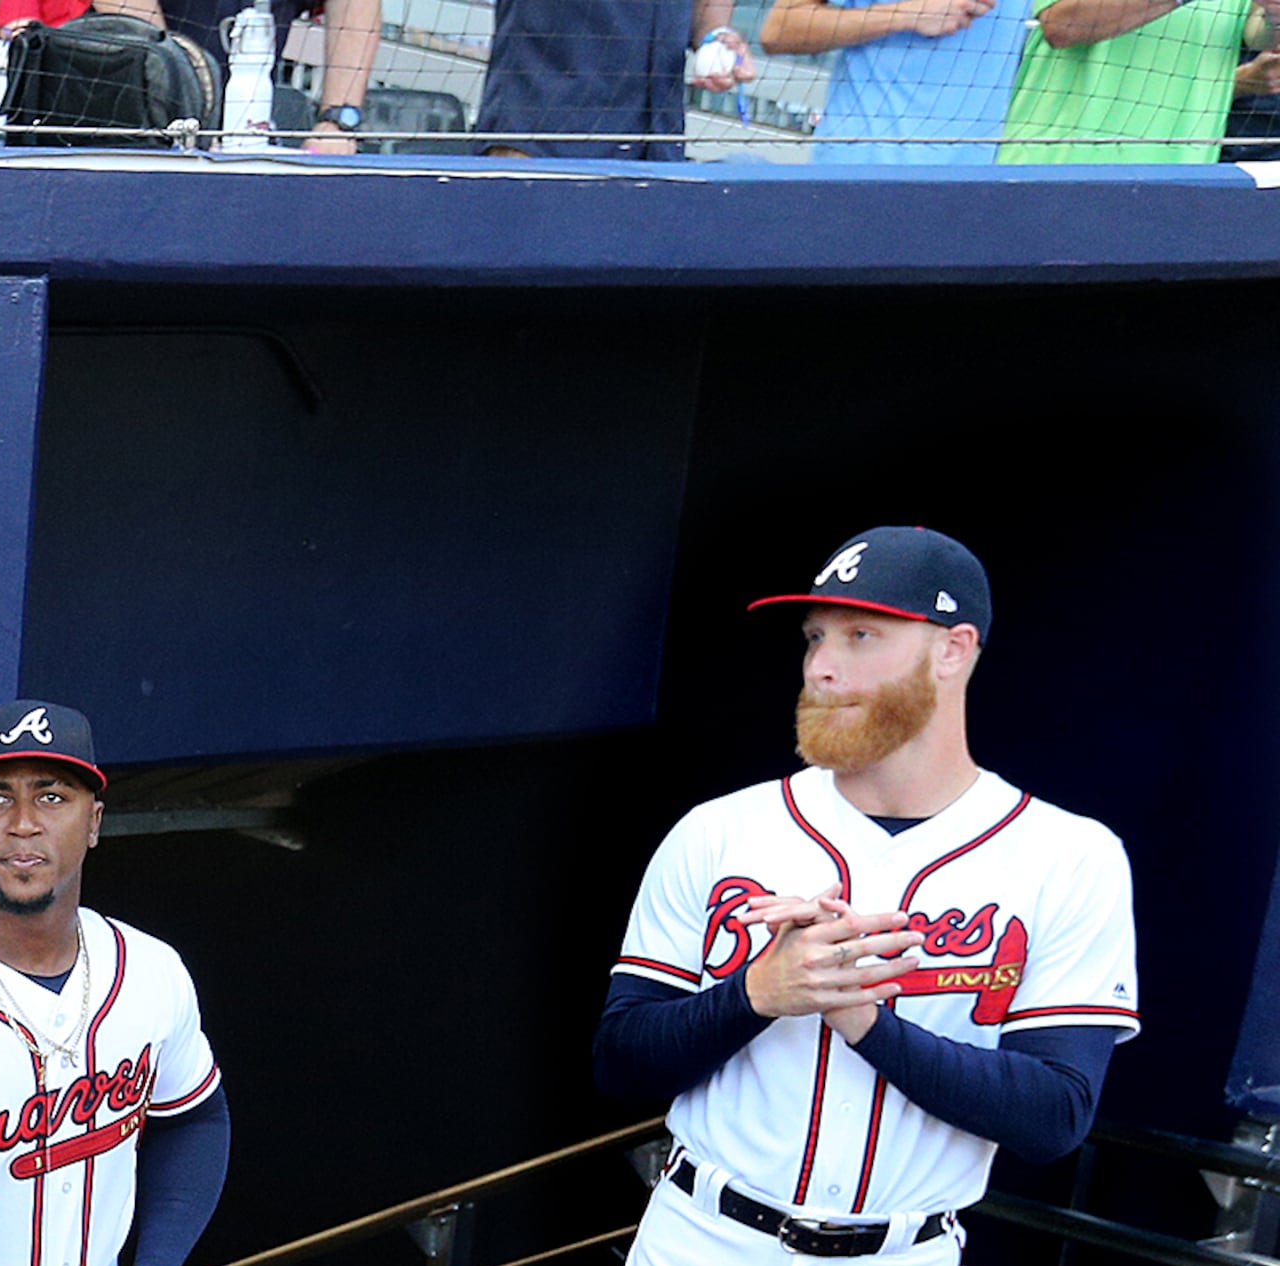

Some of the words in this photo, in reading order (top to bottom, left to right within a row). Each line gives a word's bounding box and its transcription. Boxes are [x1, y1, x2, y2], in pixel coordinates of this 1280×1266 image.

[814, 541, 868, 586] A
[0, 707, 53, 745] A
[703, 876, 999, 979] Bes
